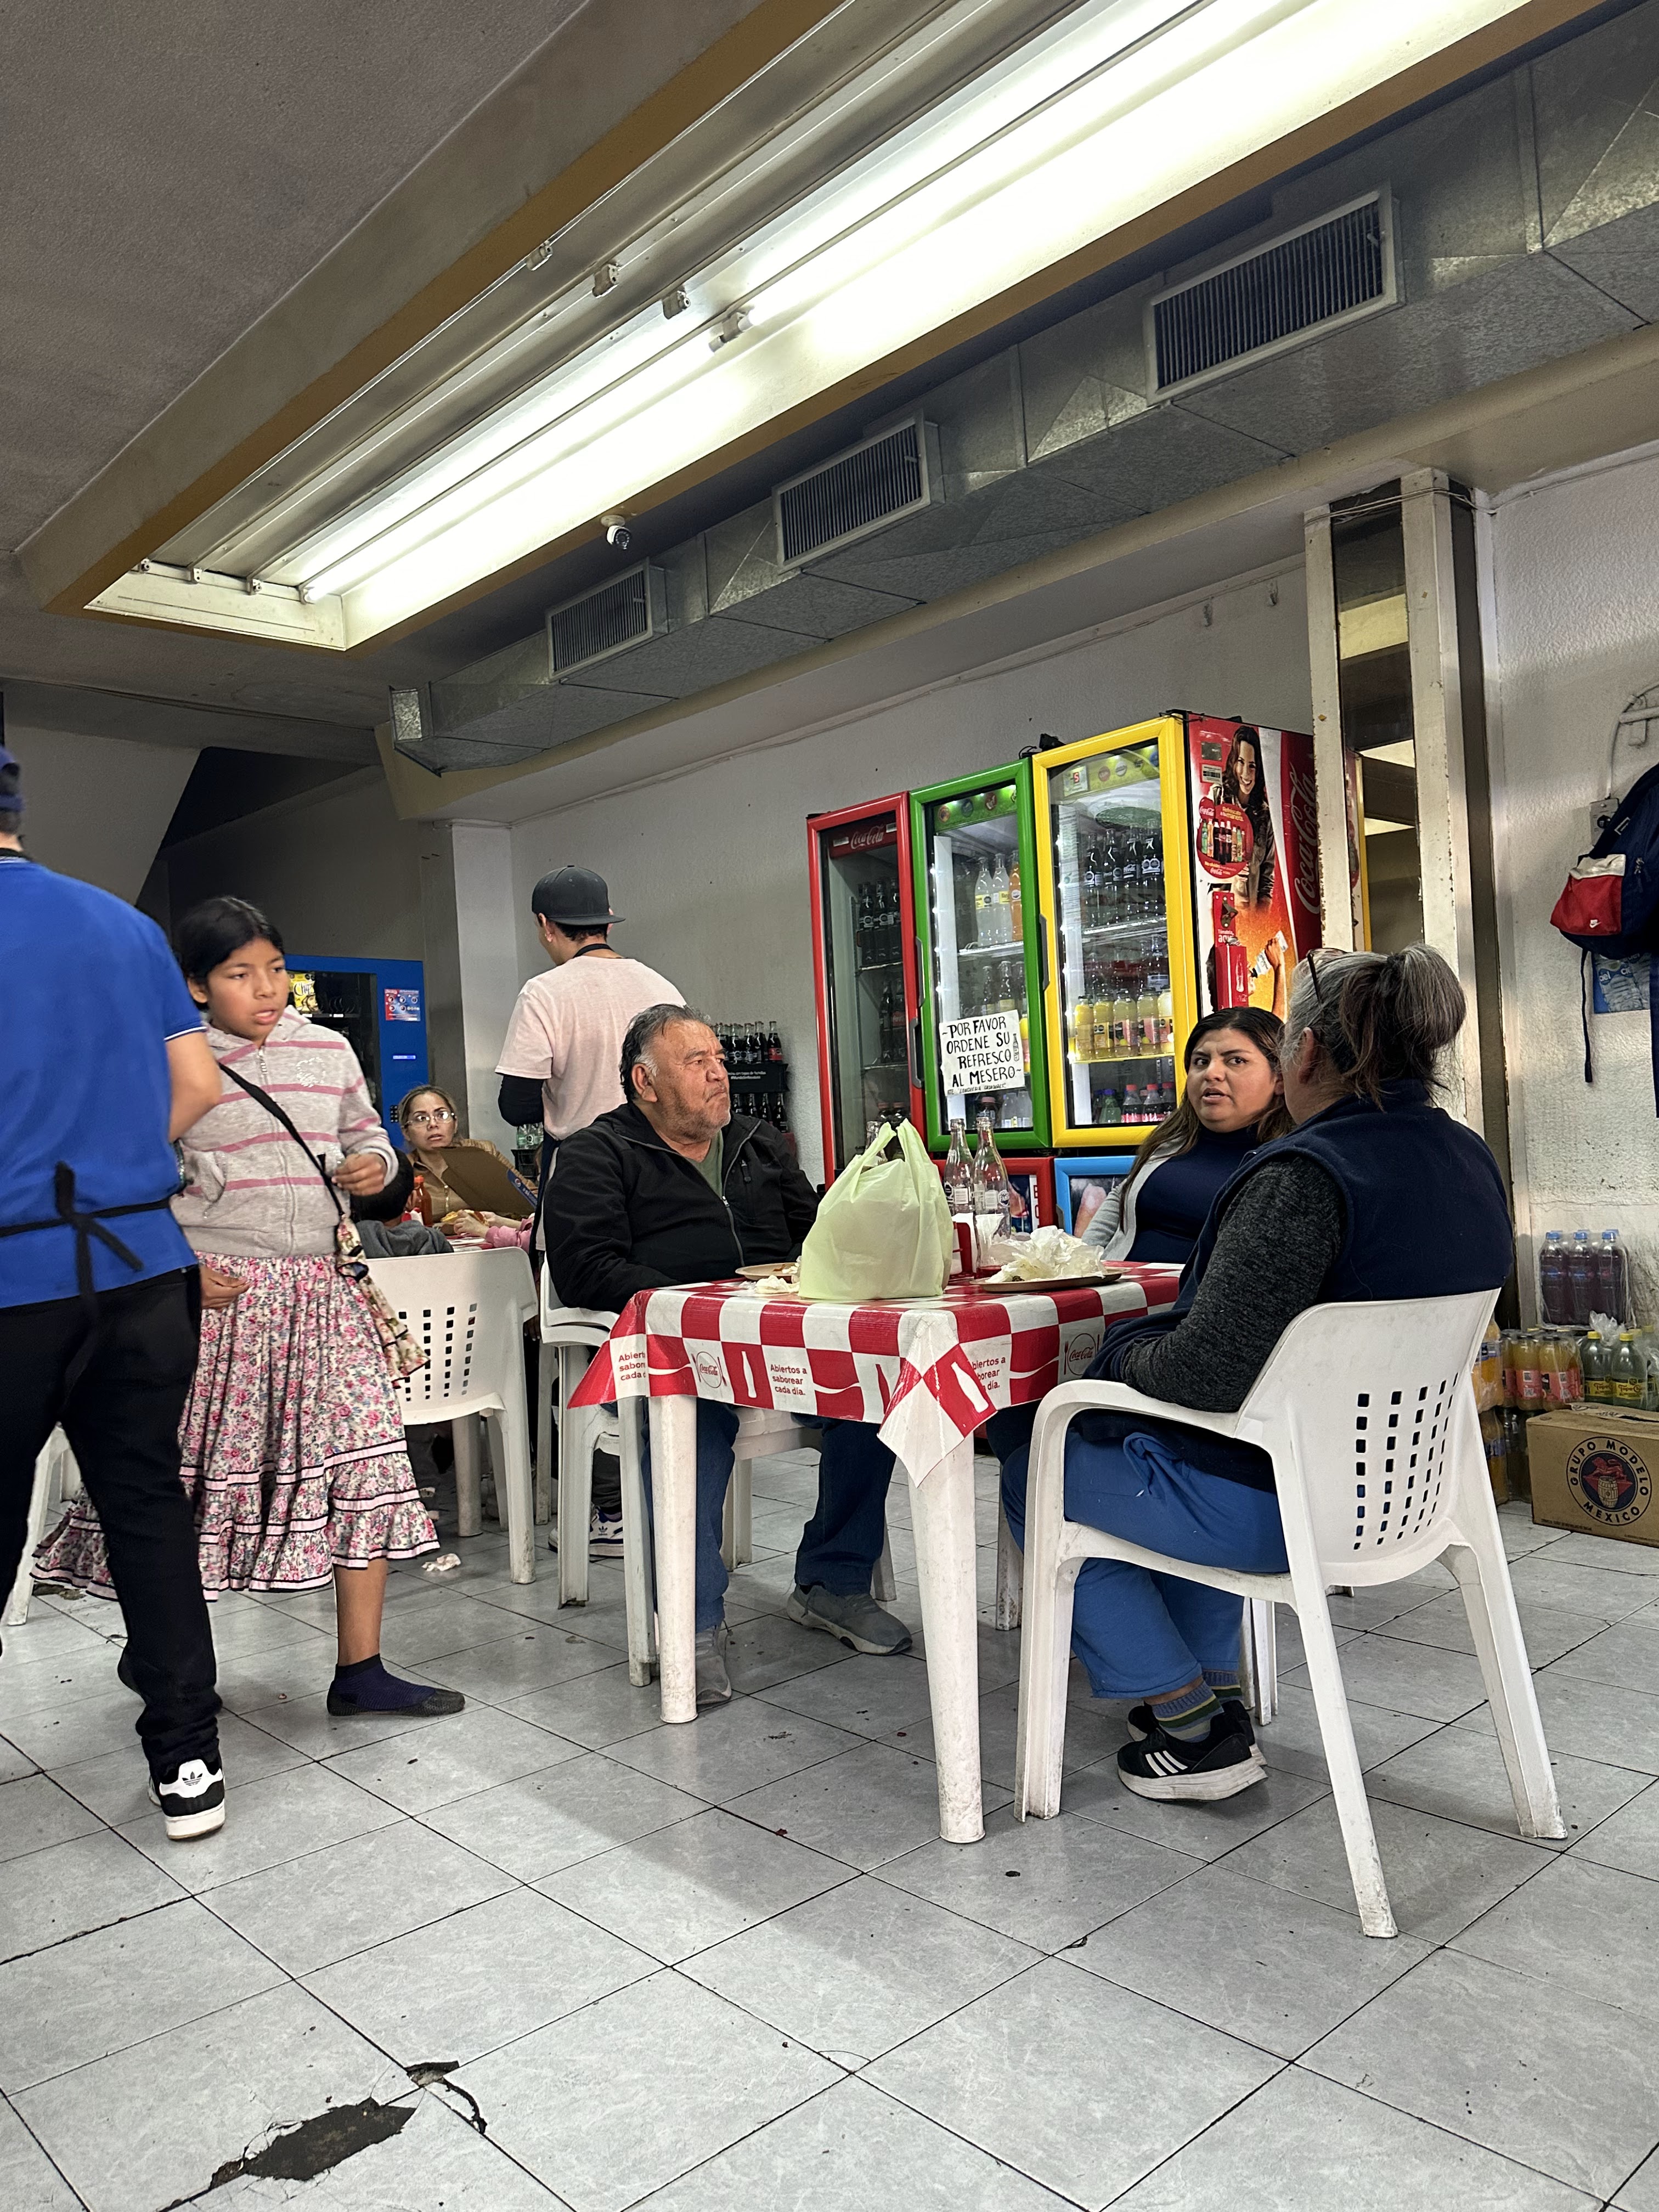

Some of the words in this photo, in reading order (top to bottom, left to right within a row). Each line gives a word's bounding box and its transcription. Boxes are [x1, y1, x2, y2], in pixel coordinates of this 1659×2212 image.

[851, 824, 884, 849] Coca-Cola
[973, 1016, 1006, 1034] FAVOR
[946, 1035, 990, 1054] ORDENE
[996, 1031, 1010, 1047] SU
[957, 1048, 1011, 1069] REFRESCO
[952, 1073, 964, 1087] AL
[618, 1351, 646, 1362] Abiert
[1069, 1346, 1094, 1362] Coca-Cola
[699, 1363, 718, 1376] Coca-Cola
[770, 1364, 800, 1374] Abiertos
[972, 1358, 999, 1370] biertos
[620, 1372, 642, 1381] cada
[772, 1375, 803, 1385] saborear
[977, 1369, 1000, 1381] borear
[775, 1386, 791, 1394] cada
[988, 1380, 1000, 1390] día.
[1570, 1441, 1596, 1486] GRUPO
[1606, 1440, 1649, 1496] MODELO
[1583, 1501, 1640, 1523] MEXICO
